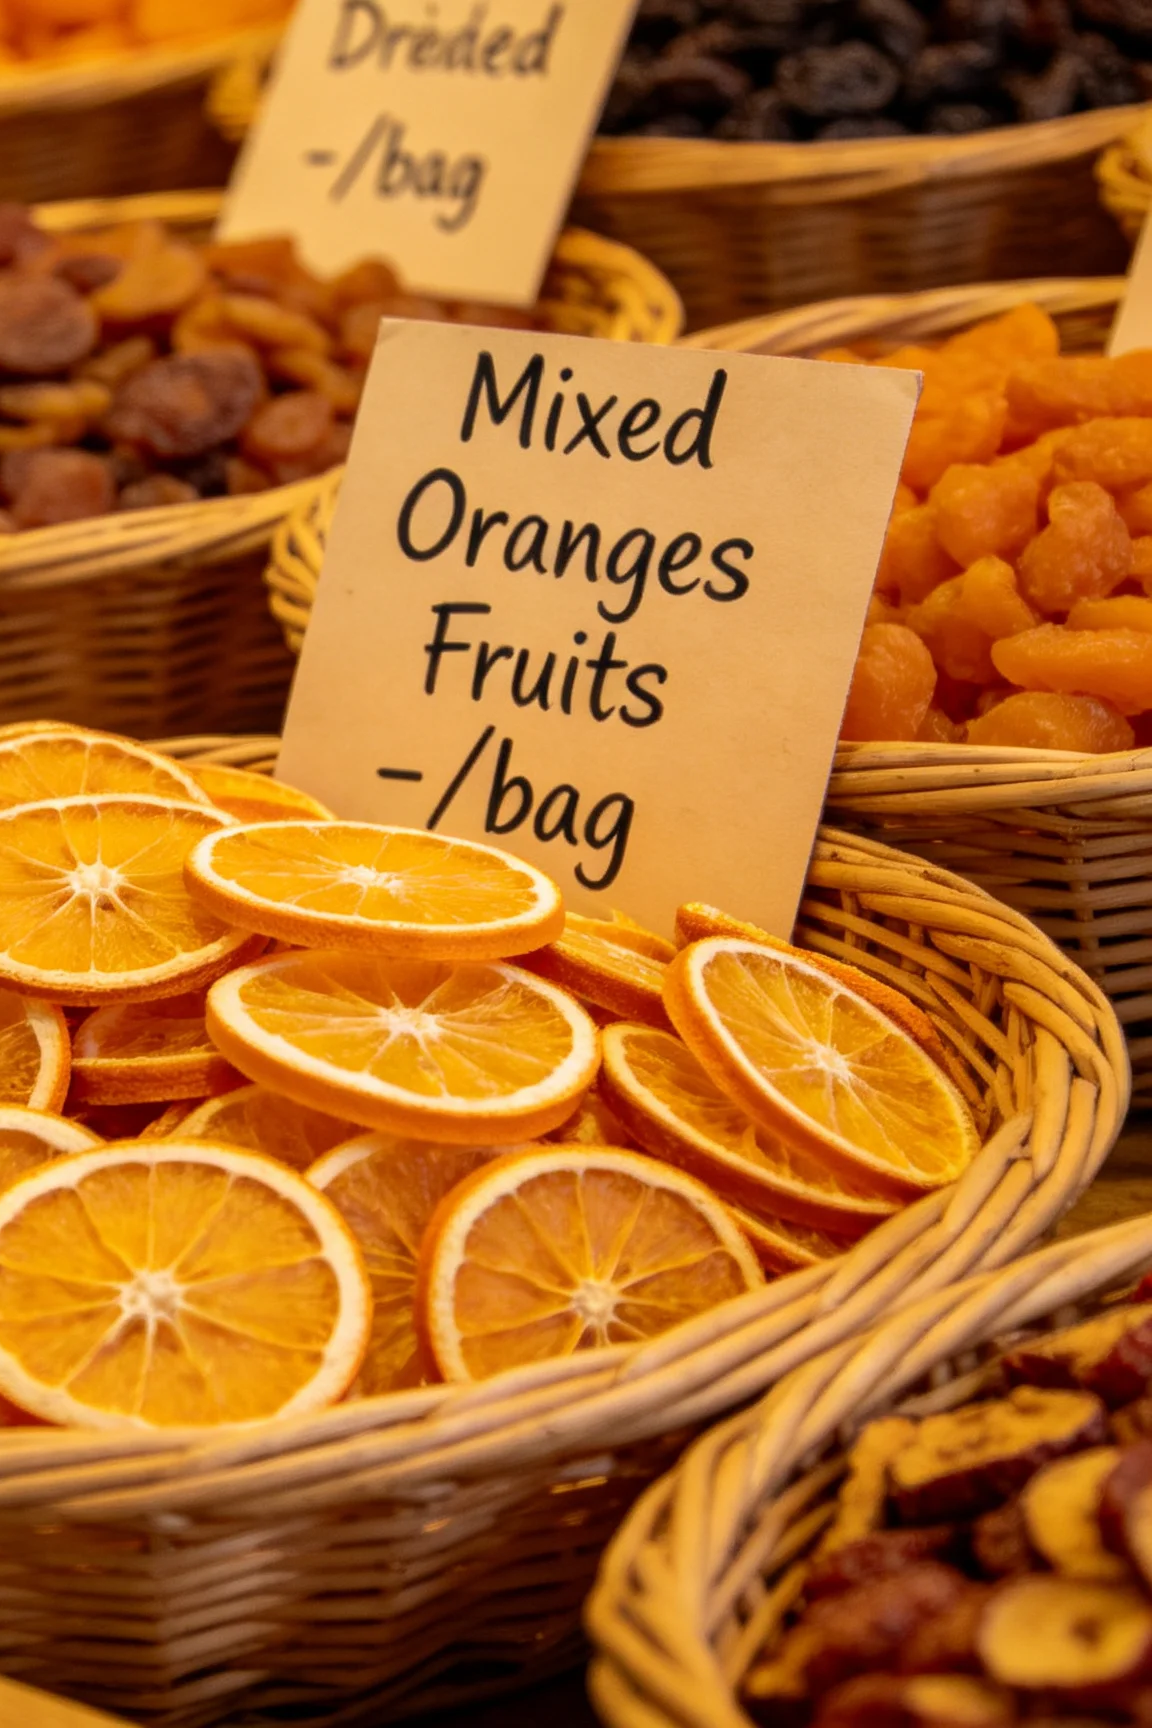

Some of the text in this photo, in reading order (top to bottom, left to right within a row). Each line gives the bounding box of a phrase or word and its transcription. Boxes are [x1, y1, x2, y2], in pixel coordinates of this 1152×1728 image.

[305, 113, 487, 233] -/bag
[460, 351, 728, 469] Mixed
[397, 468, 754, 623] Oranges
[424, 602, 668, 728] Fruits
[377, 725, 635, 891] -/bag
